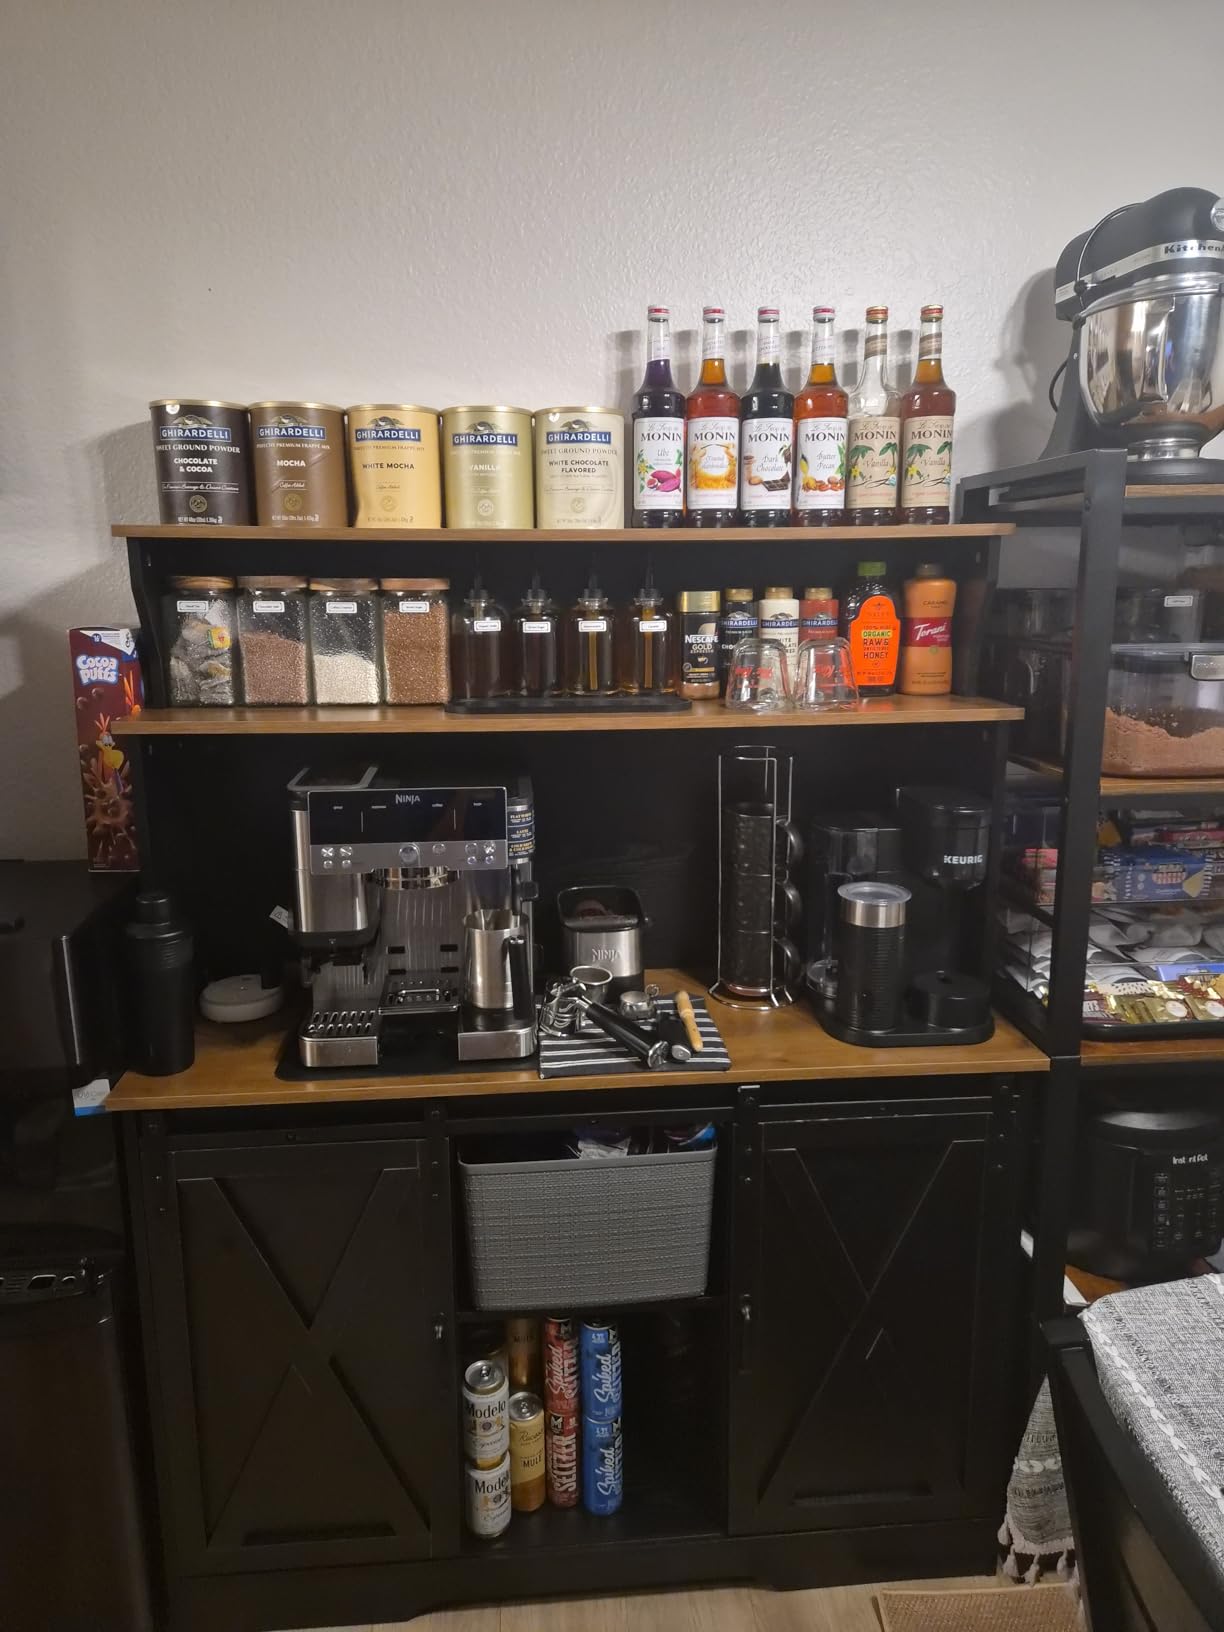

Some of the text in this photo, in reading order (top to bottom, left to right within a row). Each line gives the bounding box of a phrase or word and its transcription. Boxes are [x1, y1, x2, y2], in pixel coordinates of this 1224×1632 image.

[1164, 244, 1224, 254] Kitchen
[161, 428, 229, 439] GHIRARDELLI
[259, 427, 323, 438] GHIRARDELLI
[356, 430, 418, 440] GHIRARDELLI
[548, 433, 609, 442] GHIRARDELLI
[641, 432, 682, 442] MONIN
[695, 432, 735, 441] MONIN
[748, 433, 789, 442] MONIN
[805, 432, 845, 441] MONIN
[854, 431, 897, 441] MONIN
[911, 430, 952, 440] MONIN
[454, 435, 515, 444] GHIRARDELLI
[209, 445, 240, 453] POWDER
[276, 459, 306, 467] MOCHA
[914, 622, 947, 641] Torani
[77, 655, 118, 670] Cocoa
[395, 794, 420, 805] NINJA
[944, 854, 983, 864] KEURIG
[592, 948, 622, 962] NINJA
[1172, 1155, 1197, 1165] Instnt
[594, 1353, 613, 1402] Spiked
[467, 1400, 506, 1418] Modelo
[522, 1455, 543, 1469] MULE
[552, 1431, 576, 1492] SELTZER
[596, 1446, 615, 1496] Spiked
